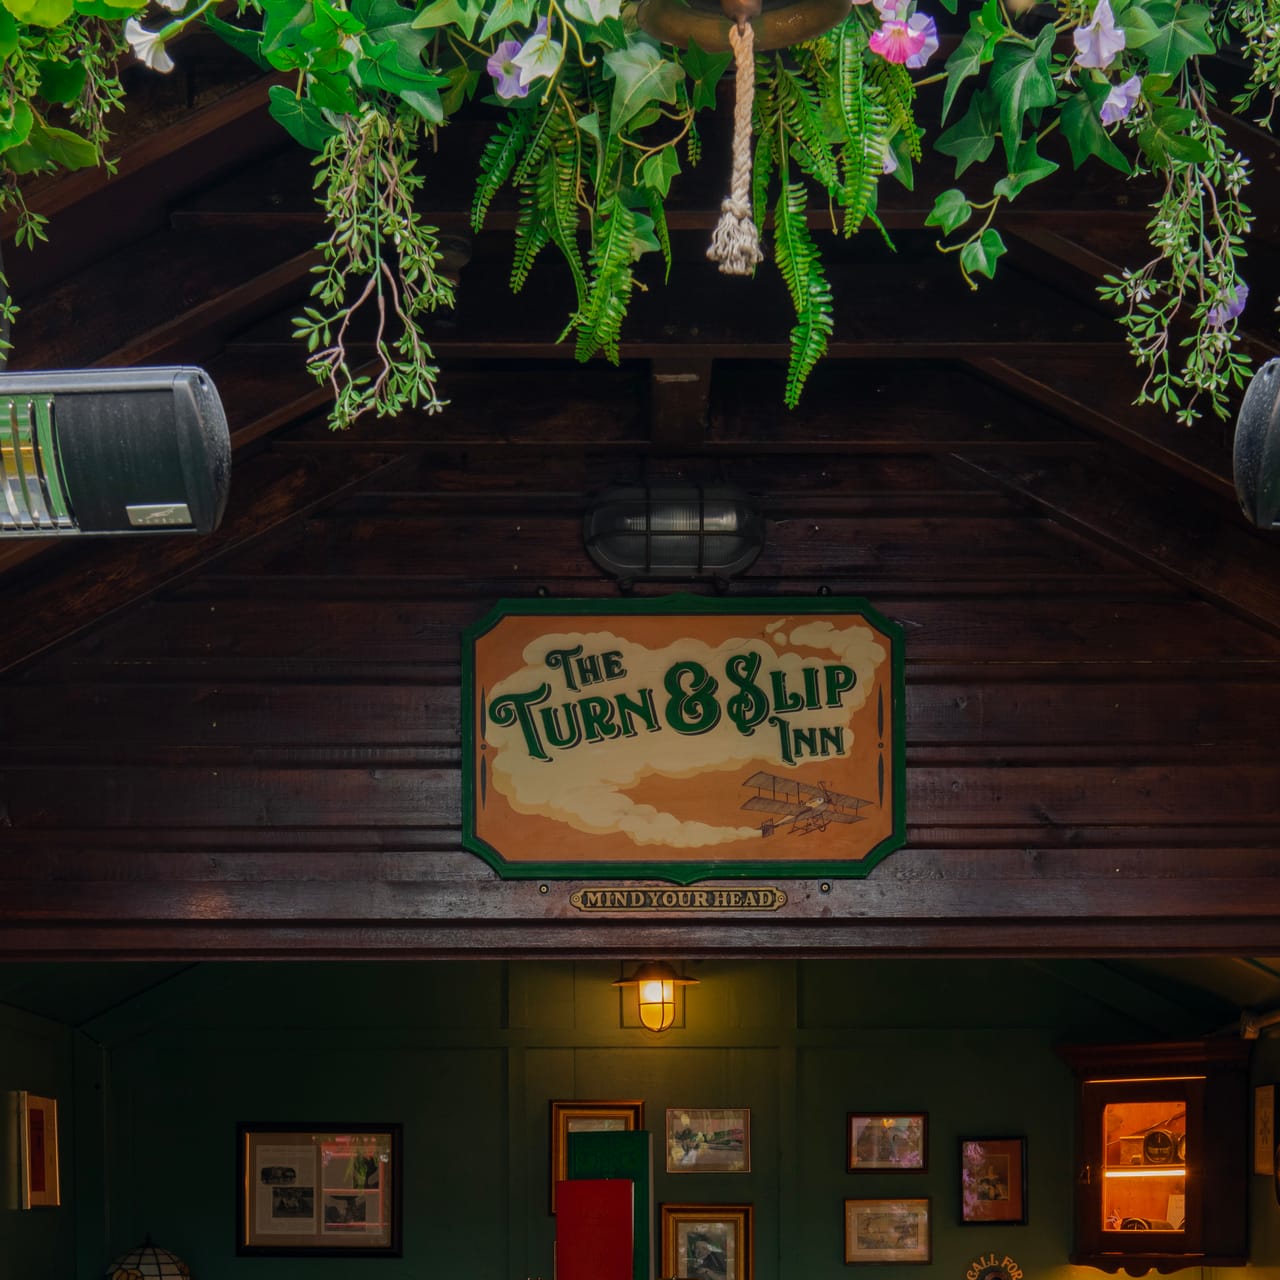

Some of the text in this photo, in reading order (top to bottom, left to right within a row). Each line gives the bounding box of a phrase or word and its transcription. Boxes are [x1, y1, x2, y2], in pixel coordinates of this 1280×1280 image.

[663, 660, 721, 736] &
[586, 891, 770, 907] MIND YOUR HEAD
[966, 1253, 1023, 1280] CALL FOR
